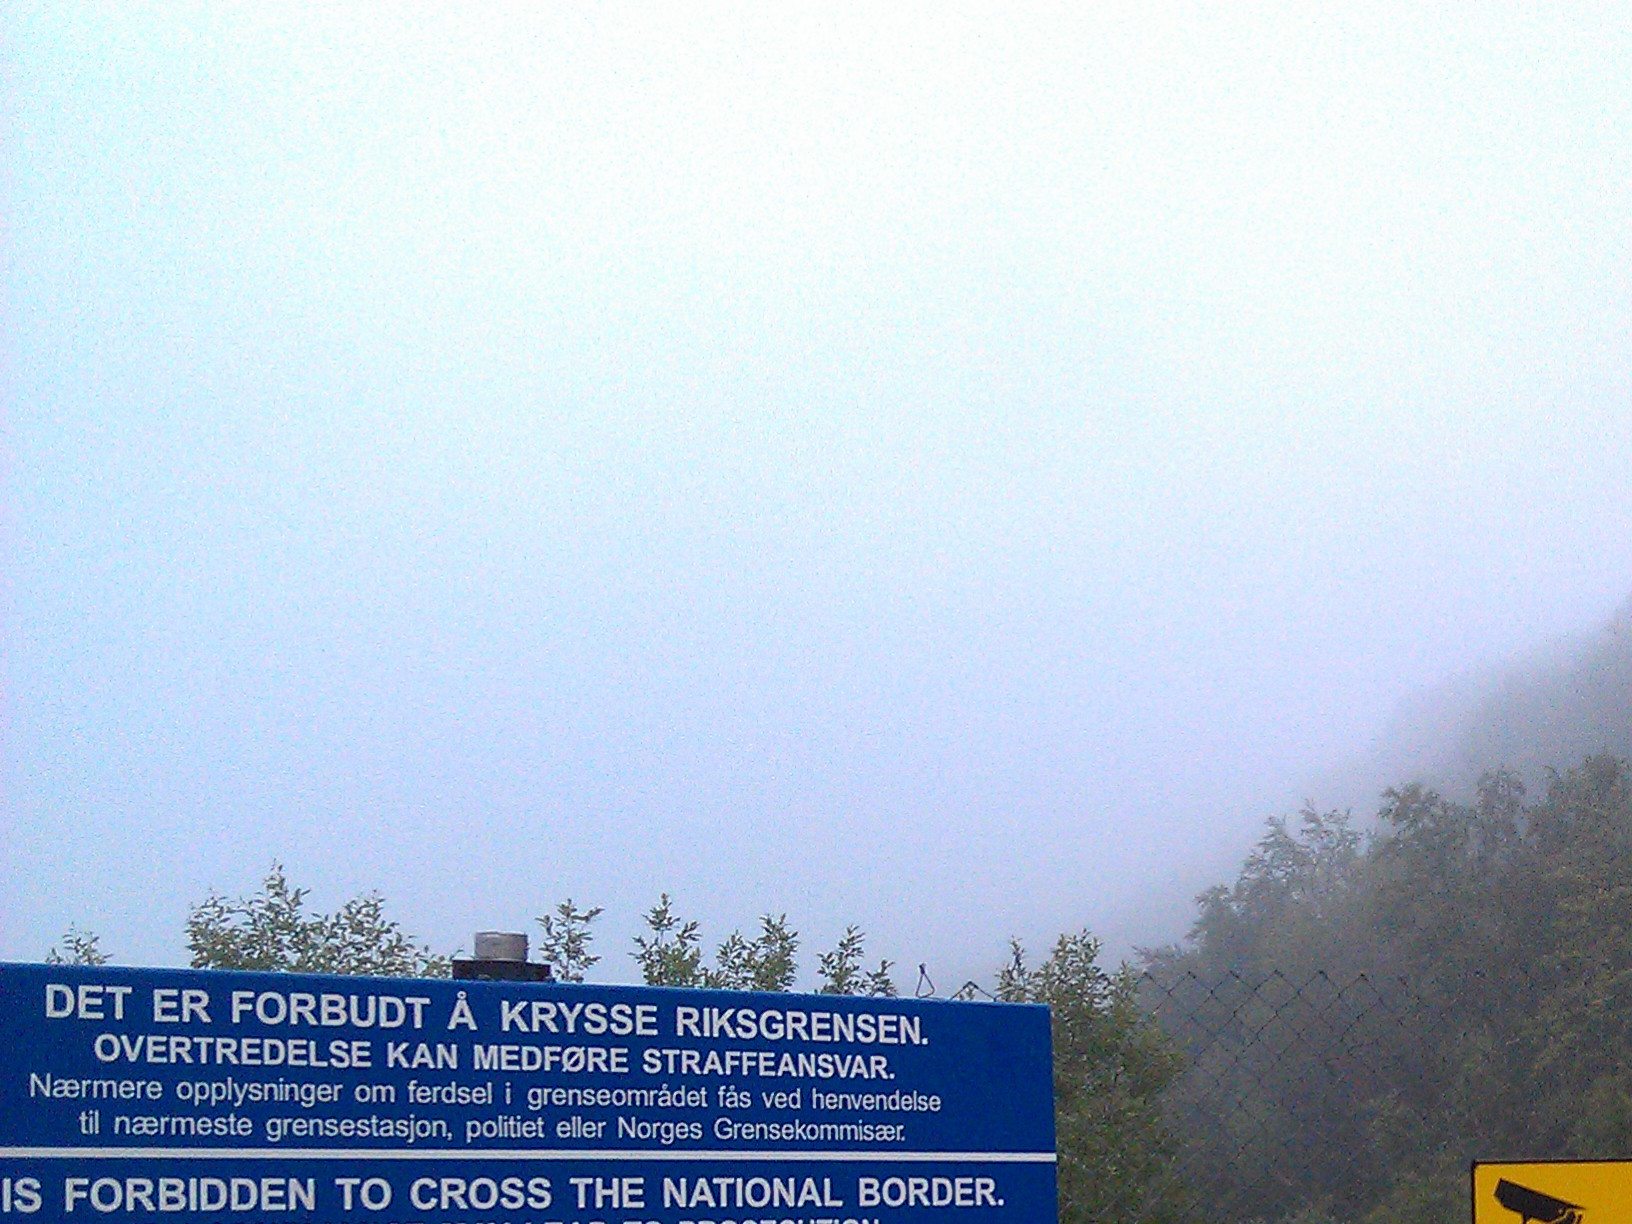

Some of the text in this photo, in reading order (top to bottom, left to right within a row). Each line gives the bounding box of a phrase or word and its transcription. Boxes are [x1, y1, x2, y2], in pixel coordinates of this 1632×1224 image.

[45, 983, 929, 1045] DET ER FORBUDT Å KRYSSE RIKSGRENSEN.
[94, 1033, 895, 1080] OVERTREDELSE KAN MEDFØRE STRAFFEANSVAR.
[30, 1072, 941, 1112] Nærmere opplysninger om ferdsel i grenseområdet fås ved henvendelse
[79, 1110, 904, 1145] til nærmeste grensestasjon, politiet eller Norges Grensekommisær.
[2, 1177, 1005, 1213] IS FORBIDDEN TO CROSS THE NATIONAL BORDER.
